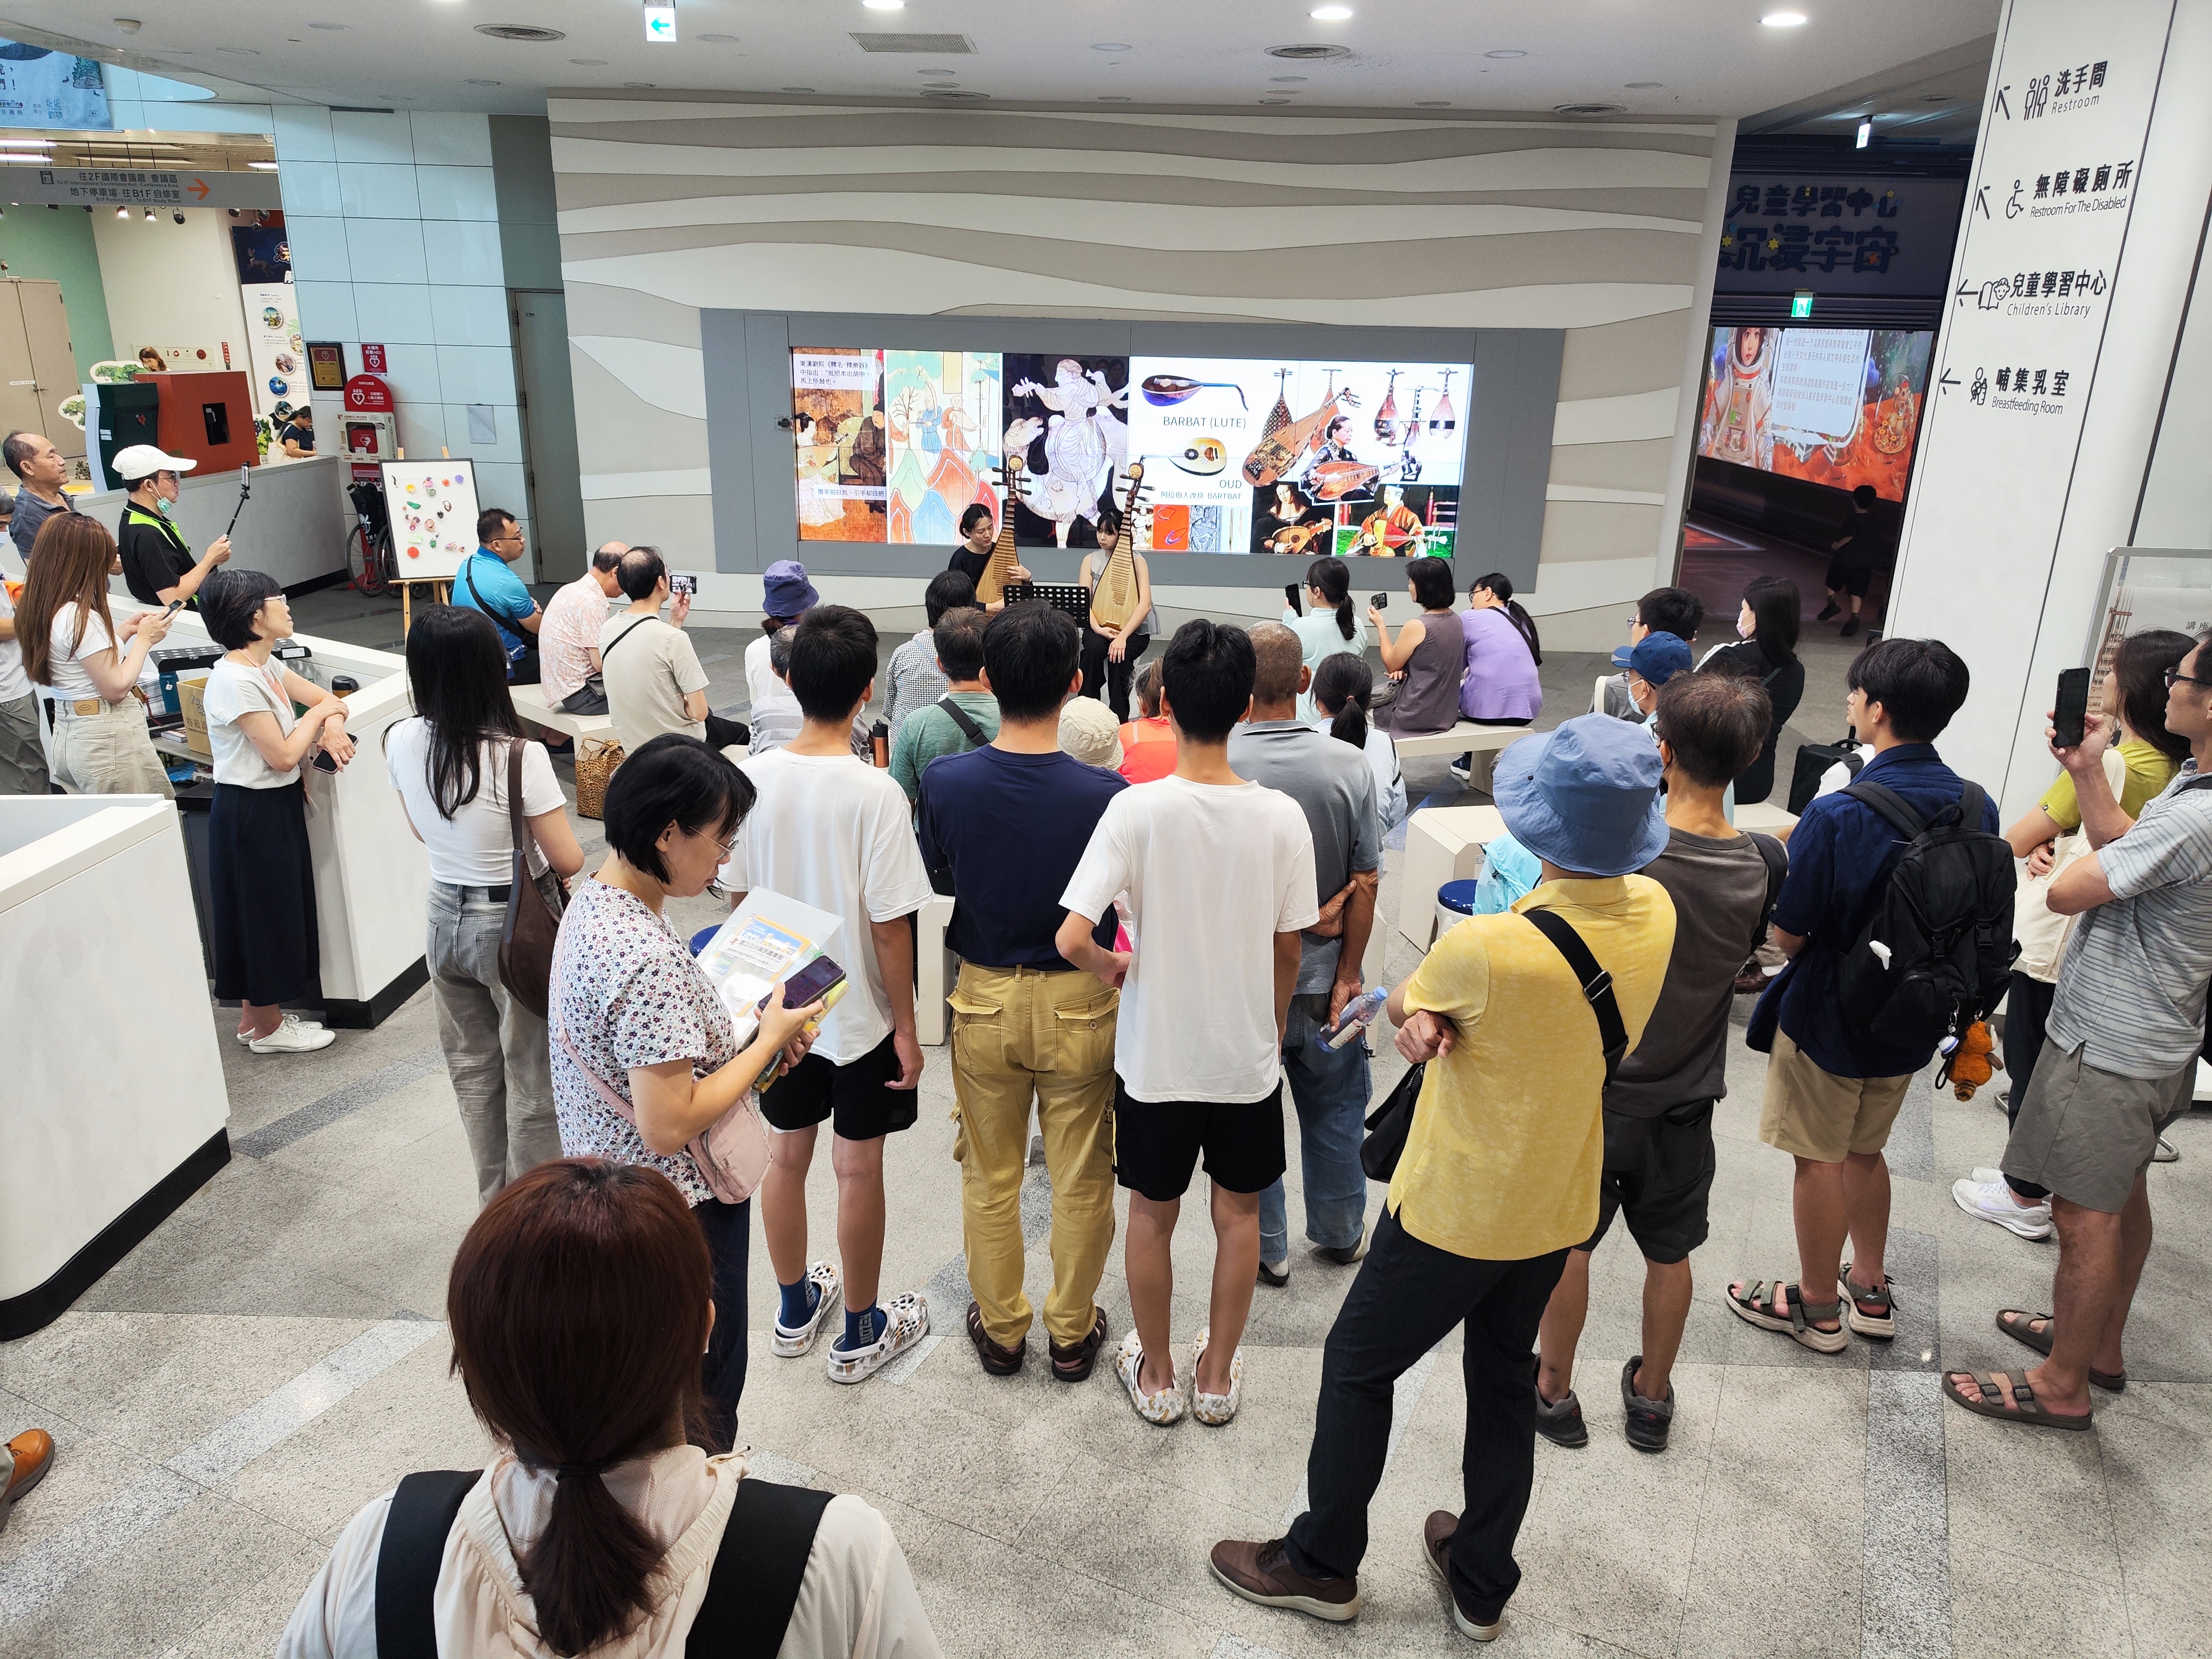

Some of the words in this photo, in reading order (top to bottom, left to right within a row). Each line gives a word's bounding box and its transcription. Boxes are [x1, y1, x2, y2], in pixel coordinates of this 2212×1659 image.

[2054, 60, 2108, 97] 洗手間
[2052, 95, 2100, 114] Restroom
[2033, 160, 2134, 200] 無障礙廁所
[1727, 185, 1900, 218] 兒童學習中心
[2030, 206, 2063, 218] Restroom
[2064, 202, 2076, 215] For
[2078, 200, 2091, 213] The
[2092, 195, 2127, 211] Disabled
[1719, 222, 1898, 273] 沉浸宇宙
[2009, 269, 2106, 298] 兒童學習中心
[2007, 302, 2052, 316] Children's
[2054, 302, 2090, 319] Library
[1996, 367, 2069, 396] 哺集乳室
[1992, 396, 2039, 415] Breastfeeding
[2040, 400, 2063, 415] Room
[1163, 416, 1207, 427] BARBAT
[1210, 417, 1246, 430] (LUTE)
[1219, 480, 1242, 488] OUD
